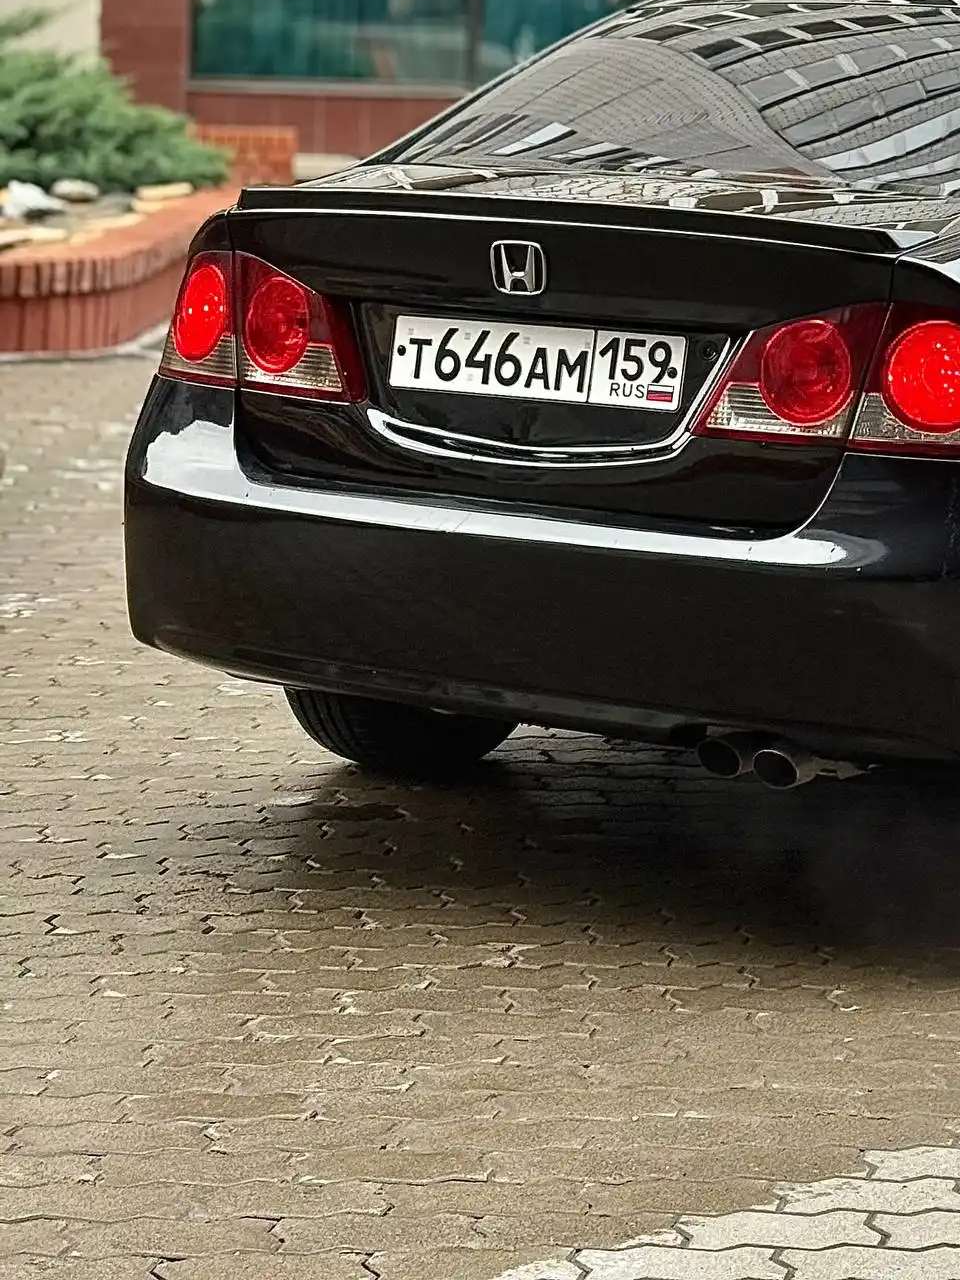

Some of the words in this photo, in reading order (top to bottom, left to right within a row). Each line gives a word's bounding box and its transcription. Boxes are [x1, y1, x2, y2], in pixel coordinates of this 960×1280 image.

[409, 327, 589, 393] Т646АМ
[599, 336, 673, 383] 159
[608, 383, 645, 399] RUS
